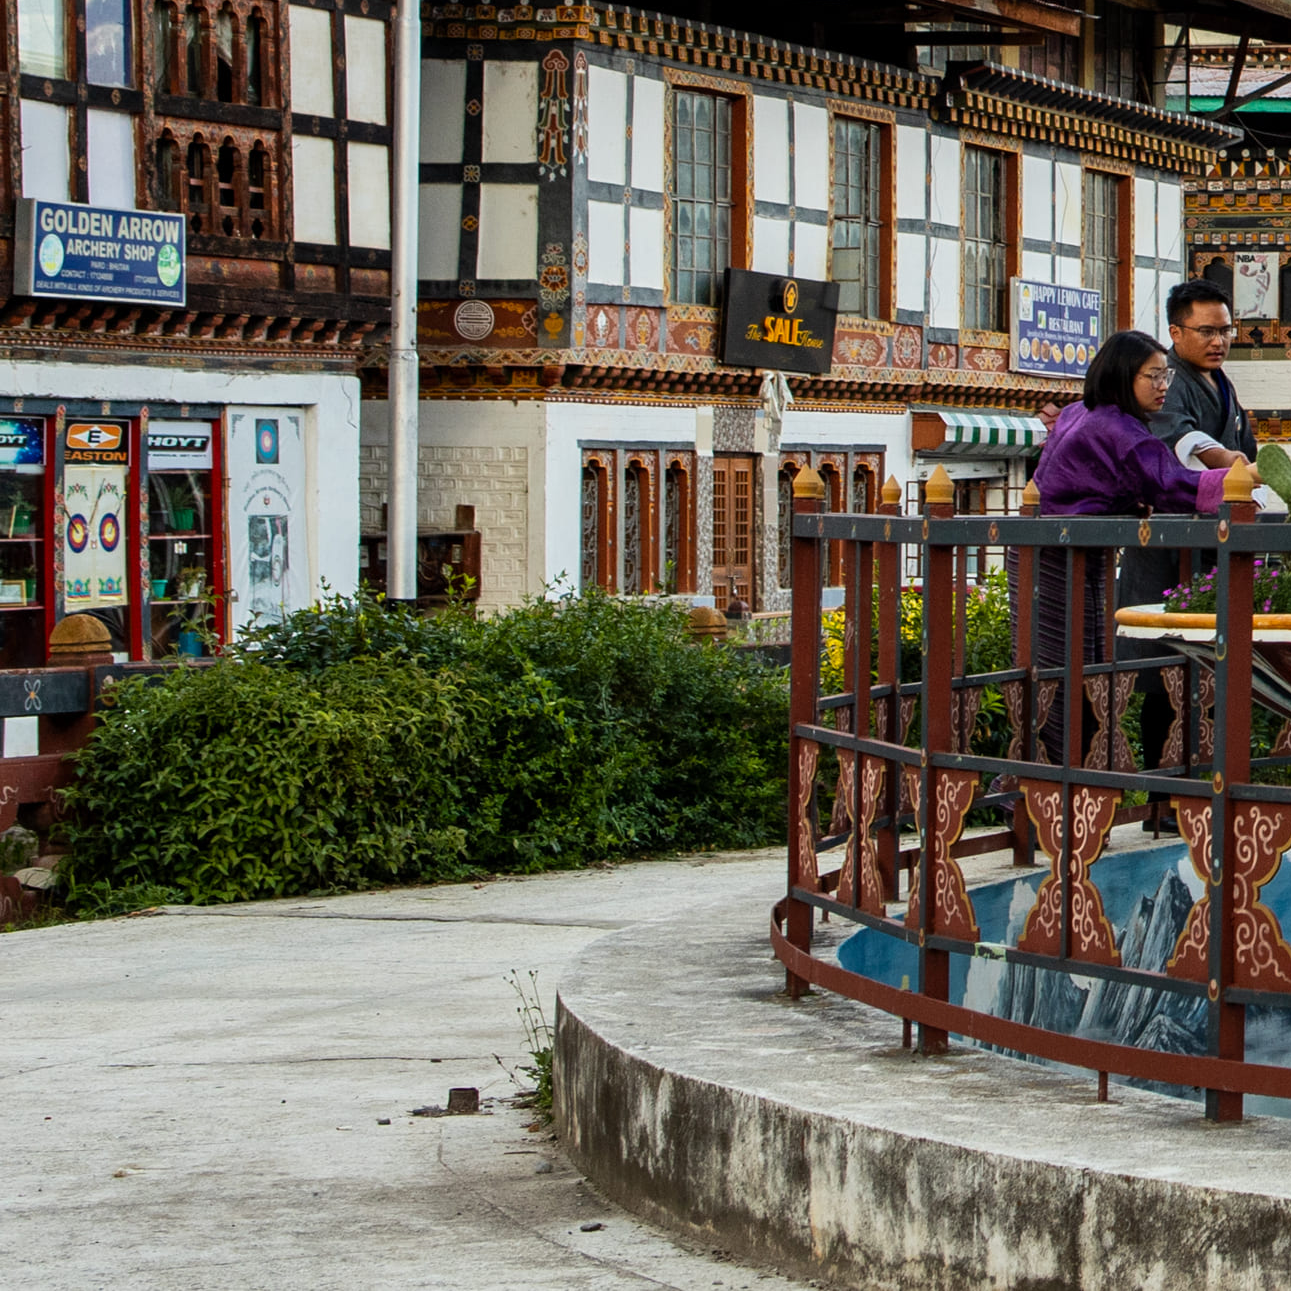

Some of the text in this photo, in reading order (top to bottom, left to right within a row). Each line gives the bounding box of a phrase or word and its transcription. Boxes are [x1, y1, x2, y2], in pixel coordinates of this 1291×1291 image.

[40, 208, 180, 244] GOLDEN ARROW
[66, 239, 155, 261] ARCHERY SHOP
[61, 269, 86, 278] CONTACT
[1032, 285, 1100, 310] HAPPY LEMON CAFE
[745, 316, 824, 348] The SALE House
[1048, 318, 1084, 334] RESTAURANT
[148, 436, 208, 447] HOYT
[64, 451, 127, 461] EASTON
